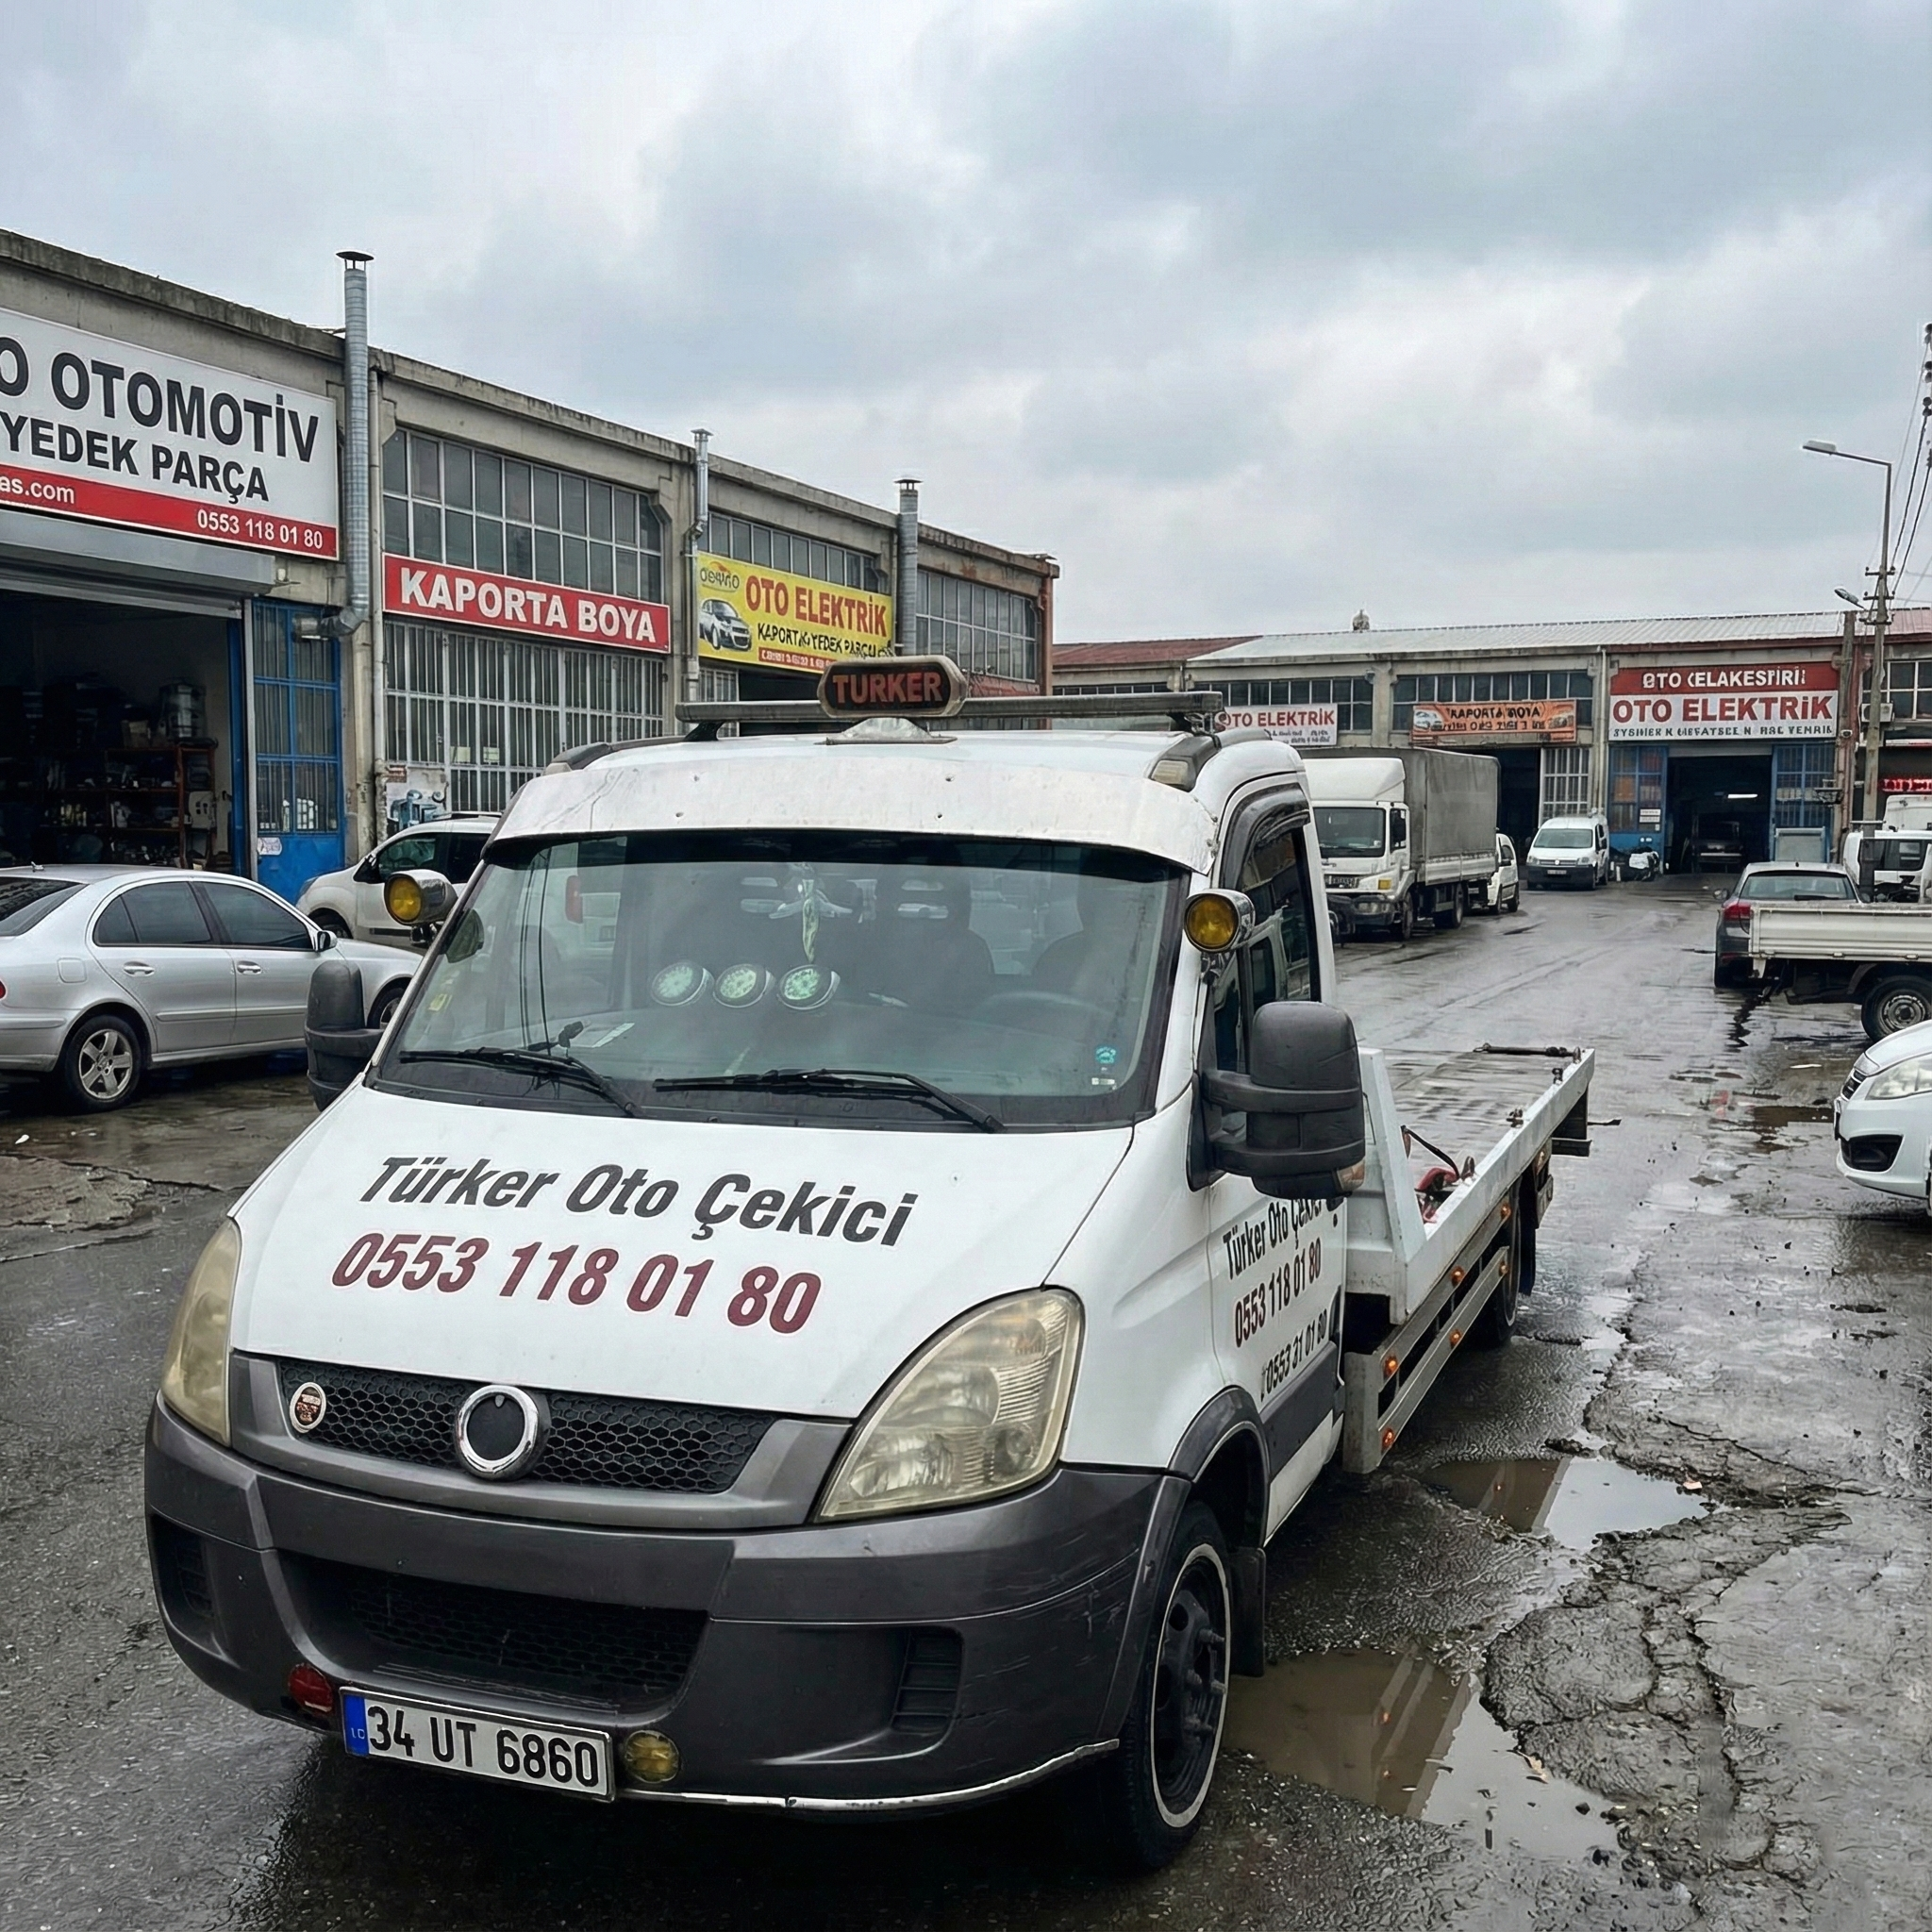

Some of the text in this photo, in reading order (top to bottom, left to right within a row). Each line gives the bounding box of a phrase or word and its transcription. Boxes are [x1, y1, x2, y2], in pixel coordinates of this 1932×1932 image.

[51, 352, 319, 463] OTOMOTİV
[0, 411, 270, 504] YEDEK PARÇA
[197, 509, 323, 549] 0553 118 01 80
[400, 569, 656, 643] KAPORTA BOYA
[746, 575, 887, 638] OTO ELEKTRİK
[832, 671, 943, 704] TURKER
[1257, 708, 1335, 727] ELEKTRİK
[1612, 695, 1833, 723] OTO ELEKTRİK
[359, 1157, 918, 1246] Türker Oto Çekici
[1223, 1220, 1266, 1280] Türker
[1268, 1201, 1289, 1248] Oto
[331, 1232, 822, 1334] 0553 118 01 80
[1235, 1237, 1322, 1348] 0553 118 01 80
[367, 1706, 599, 1788] 34 UT 6860
